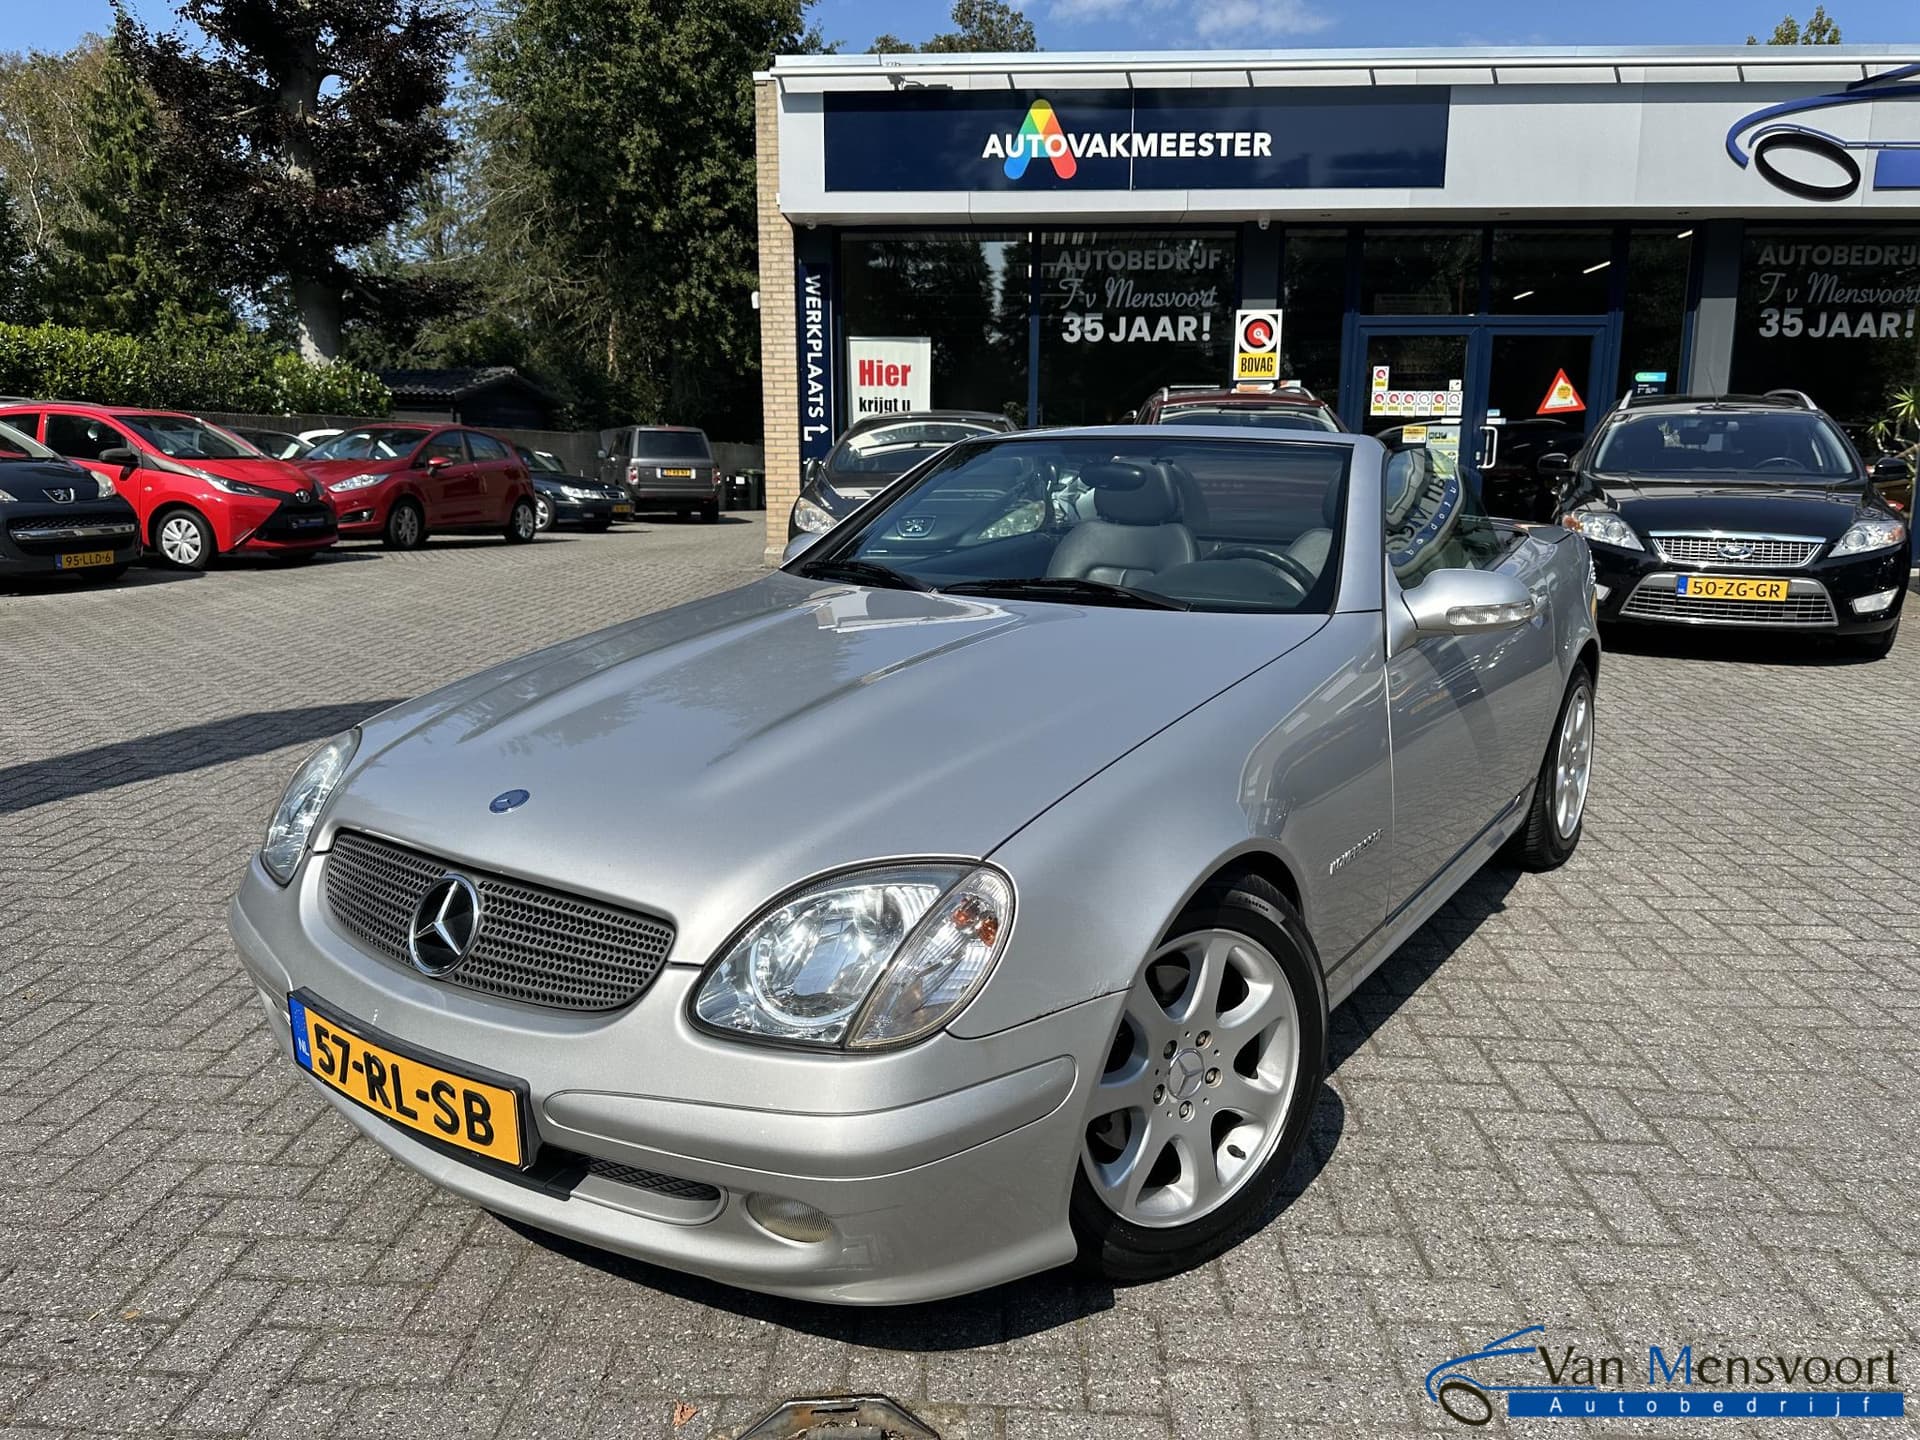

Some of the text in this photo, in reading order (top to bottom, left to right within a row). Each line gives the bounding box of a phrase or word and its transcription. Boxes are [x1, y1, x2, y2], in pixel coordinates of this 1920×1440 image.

[982, 132, 1272, 159] AUTOVAKMEESTER
[1056, 250, 1222, 270] AUTOBEDRIJF
[1758, 246, 1920, 265] AUTOBEDRIJ
[1105, 276, 1218, 309] Mensvoort
[1062, 312, 1212, 342] 35 JAAR!
[1758, 308, 1916, 338] 35 JAAR!
[805, 274, 824, 418] WERKPLAATS
[859, 360, 911, 386] Hier
[1241, 356, 1273, 373] BOVAG
[65, 552, 111, 567] 95-LLD-6
[1692, 581, 1781, 598] 50-ZG-GR
[298, 1022, 495, 1147] NL 57-RL-SB
